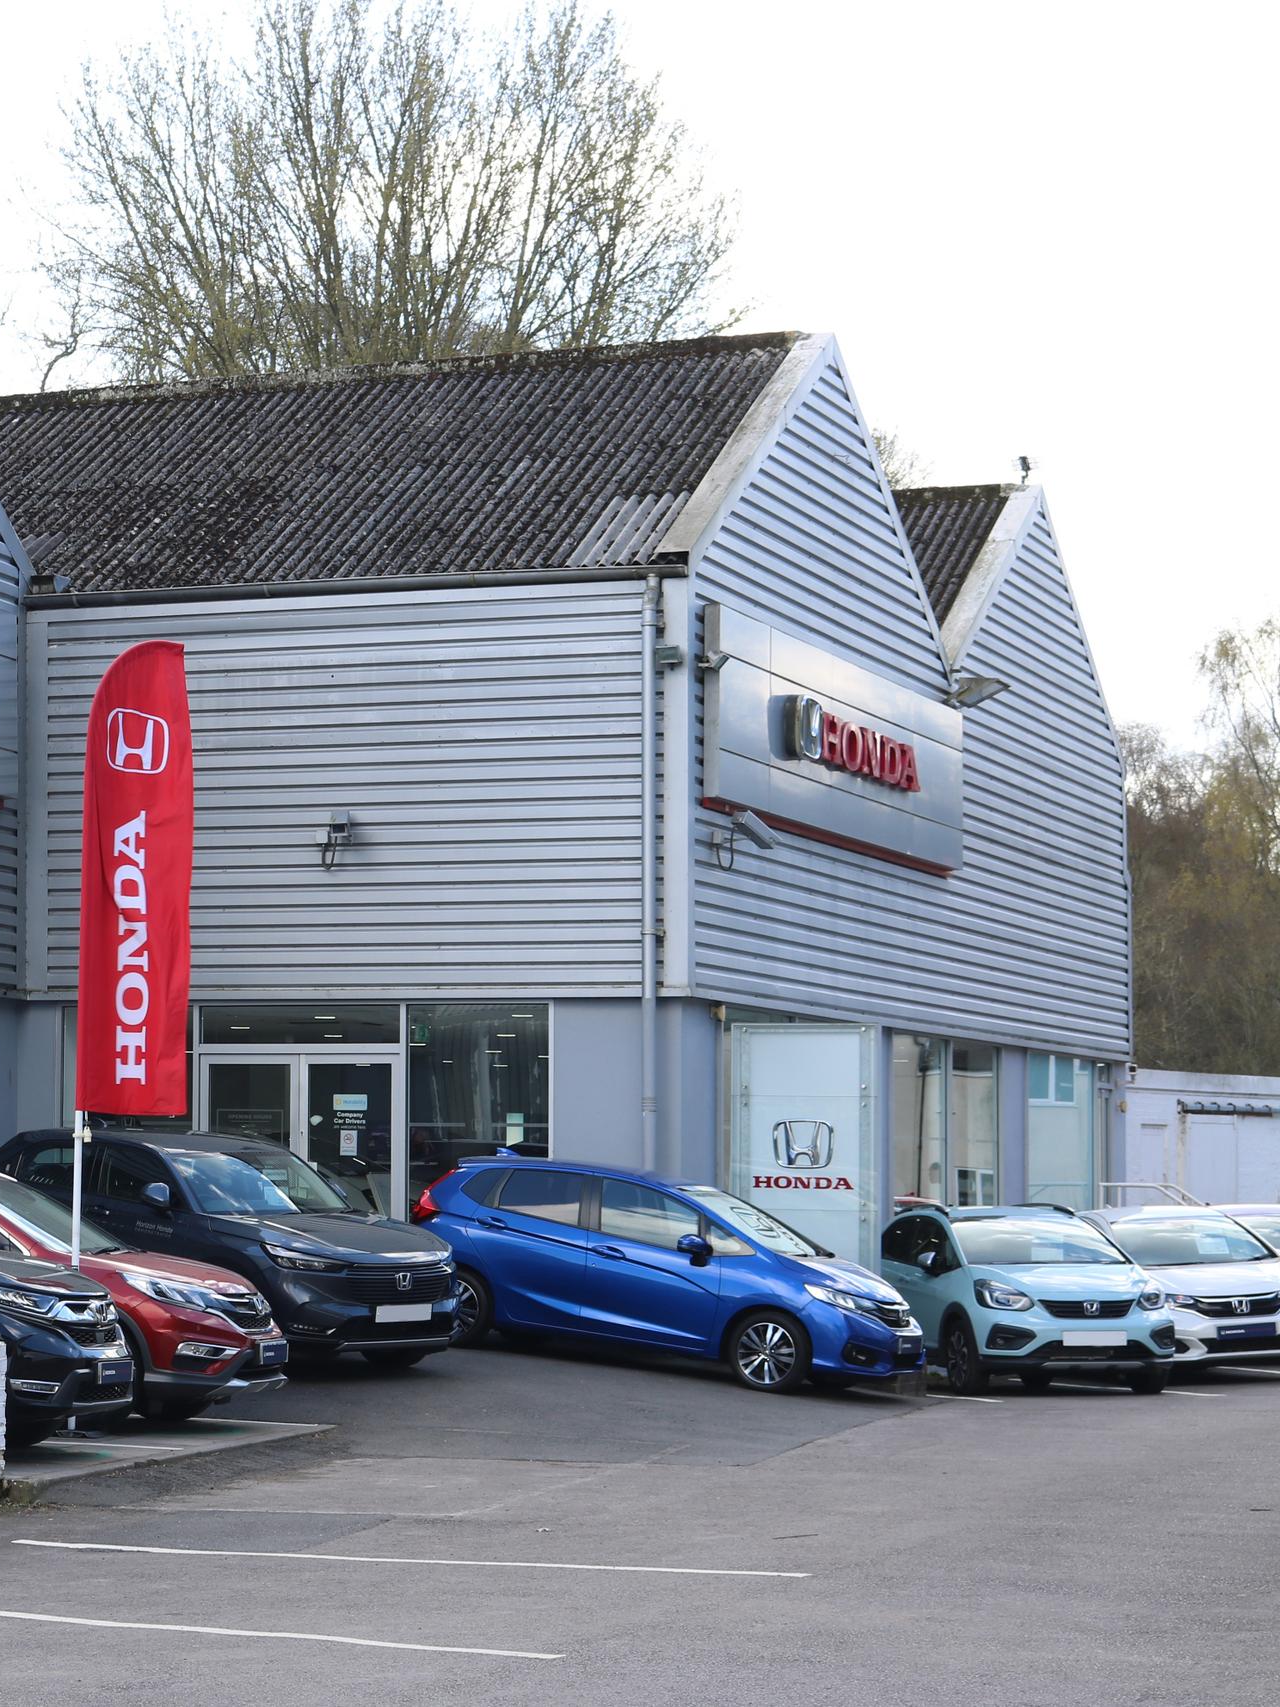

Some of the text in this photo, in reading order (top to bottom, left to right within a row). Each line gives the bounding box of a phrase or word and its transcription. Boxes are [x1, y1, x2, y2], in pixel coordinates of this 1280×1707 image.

[822, 711, 921, 792] HONDA
[113, 810, 149, 1086] HONDA
[752, 1175, 854, 1190] HONDA
